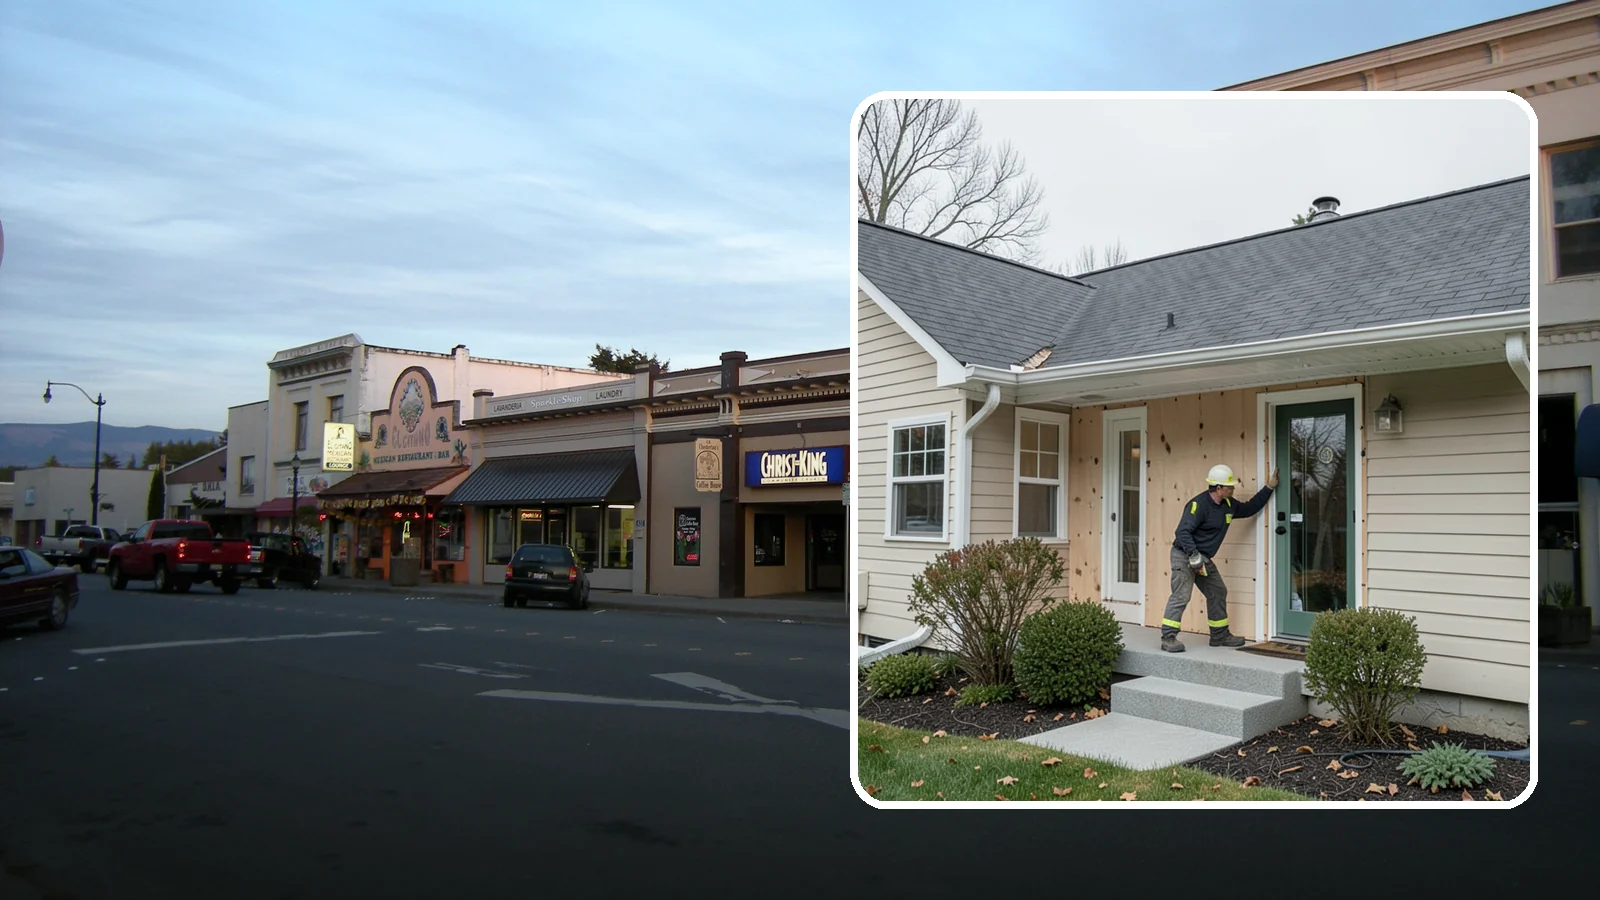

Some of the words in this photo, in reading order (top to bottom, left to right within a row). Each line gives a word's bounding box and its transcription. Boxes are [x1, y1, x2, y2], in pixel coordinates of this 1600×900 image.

[562, 394, 583, 405] Shop
[595, 389, 624, 399] LAUNDRY
[493, 402, 522, 412] LAVANDERIA
[397, 452, 433, 462] RESTAURANT
[437, 451, 450, 459] BAR
[761, 452, 798, 478] CHRIST
[799, 450, 827, 476] KING
